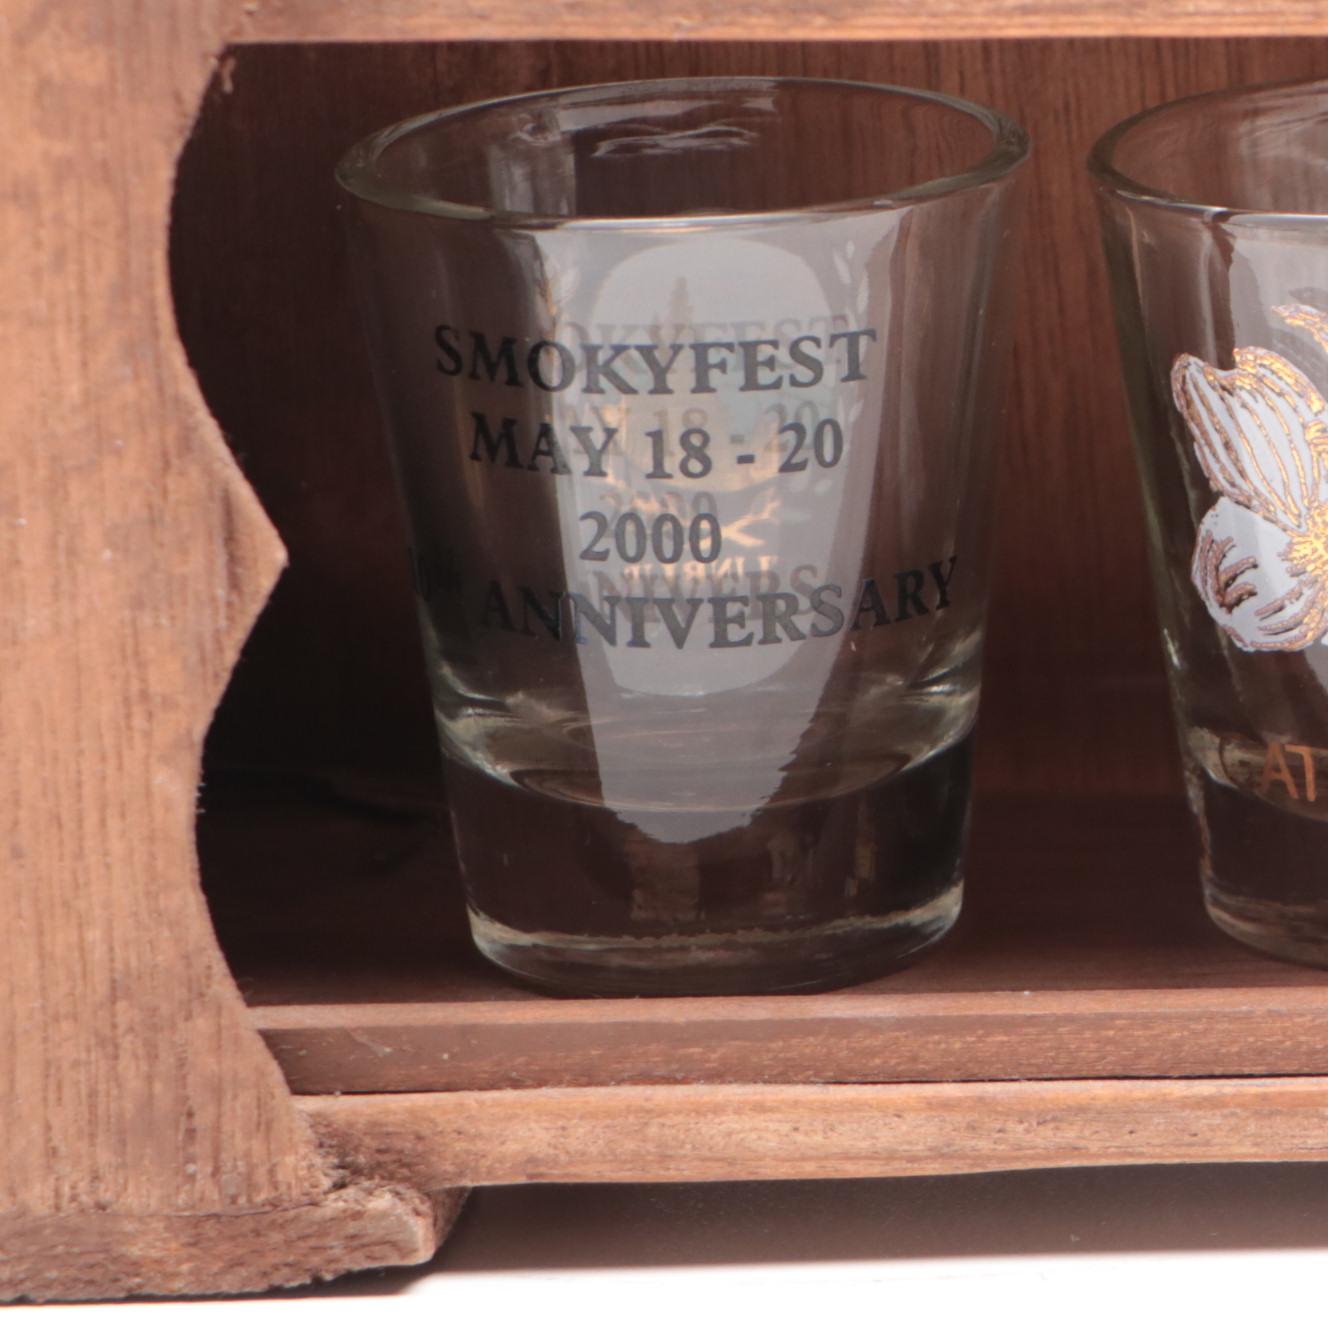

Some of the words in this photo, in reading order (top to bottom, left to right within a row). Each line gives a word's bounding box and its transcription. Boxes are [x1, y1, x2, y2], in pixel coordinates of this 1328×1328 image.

[434, 324, 878, 395] SMOKYFEST
[469, 411, 619, 478] MAY
[644, 427, 714, 480] 18
[778, 418, 844, 474] 20
[578, 510, 722, 565] 2000
[482, 556, 958, 651] ANNIVERSARY
